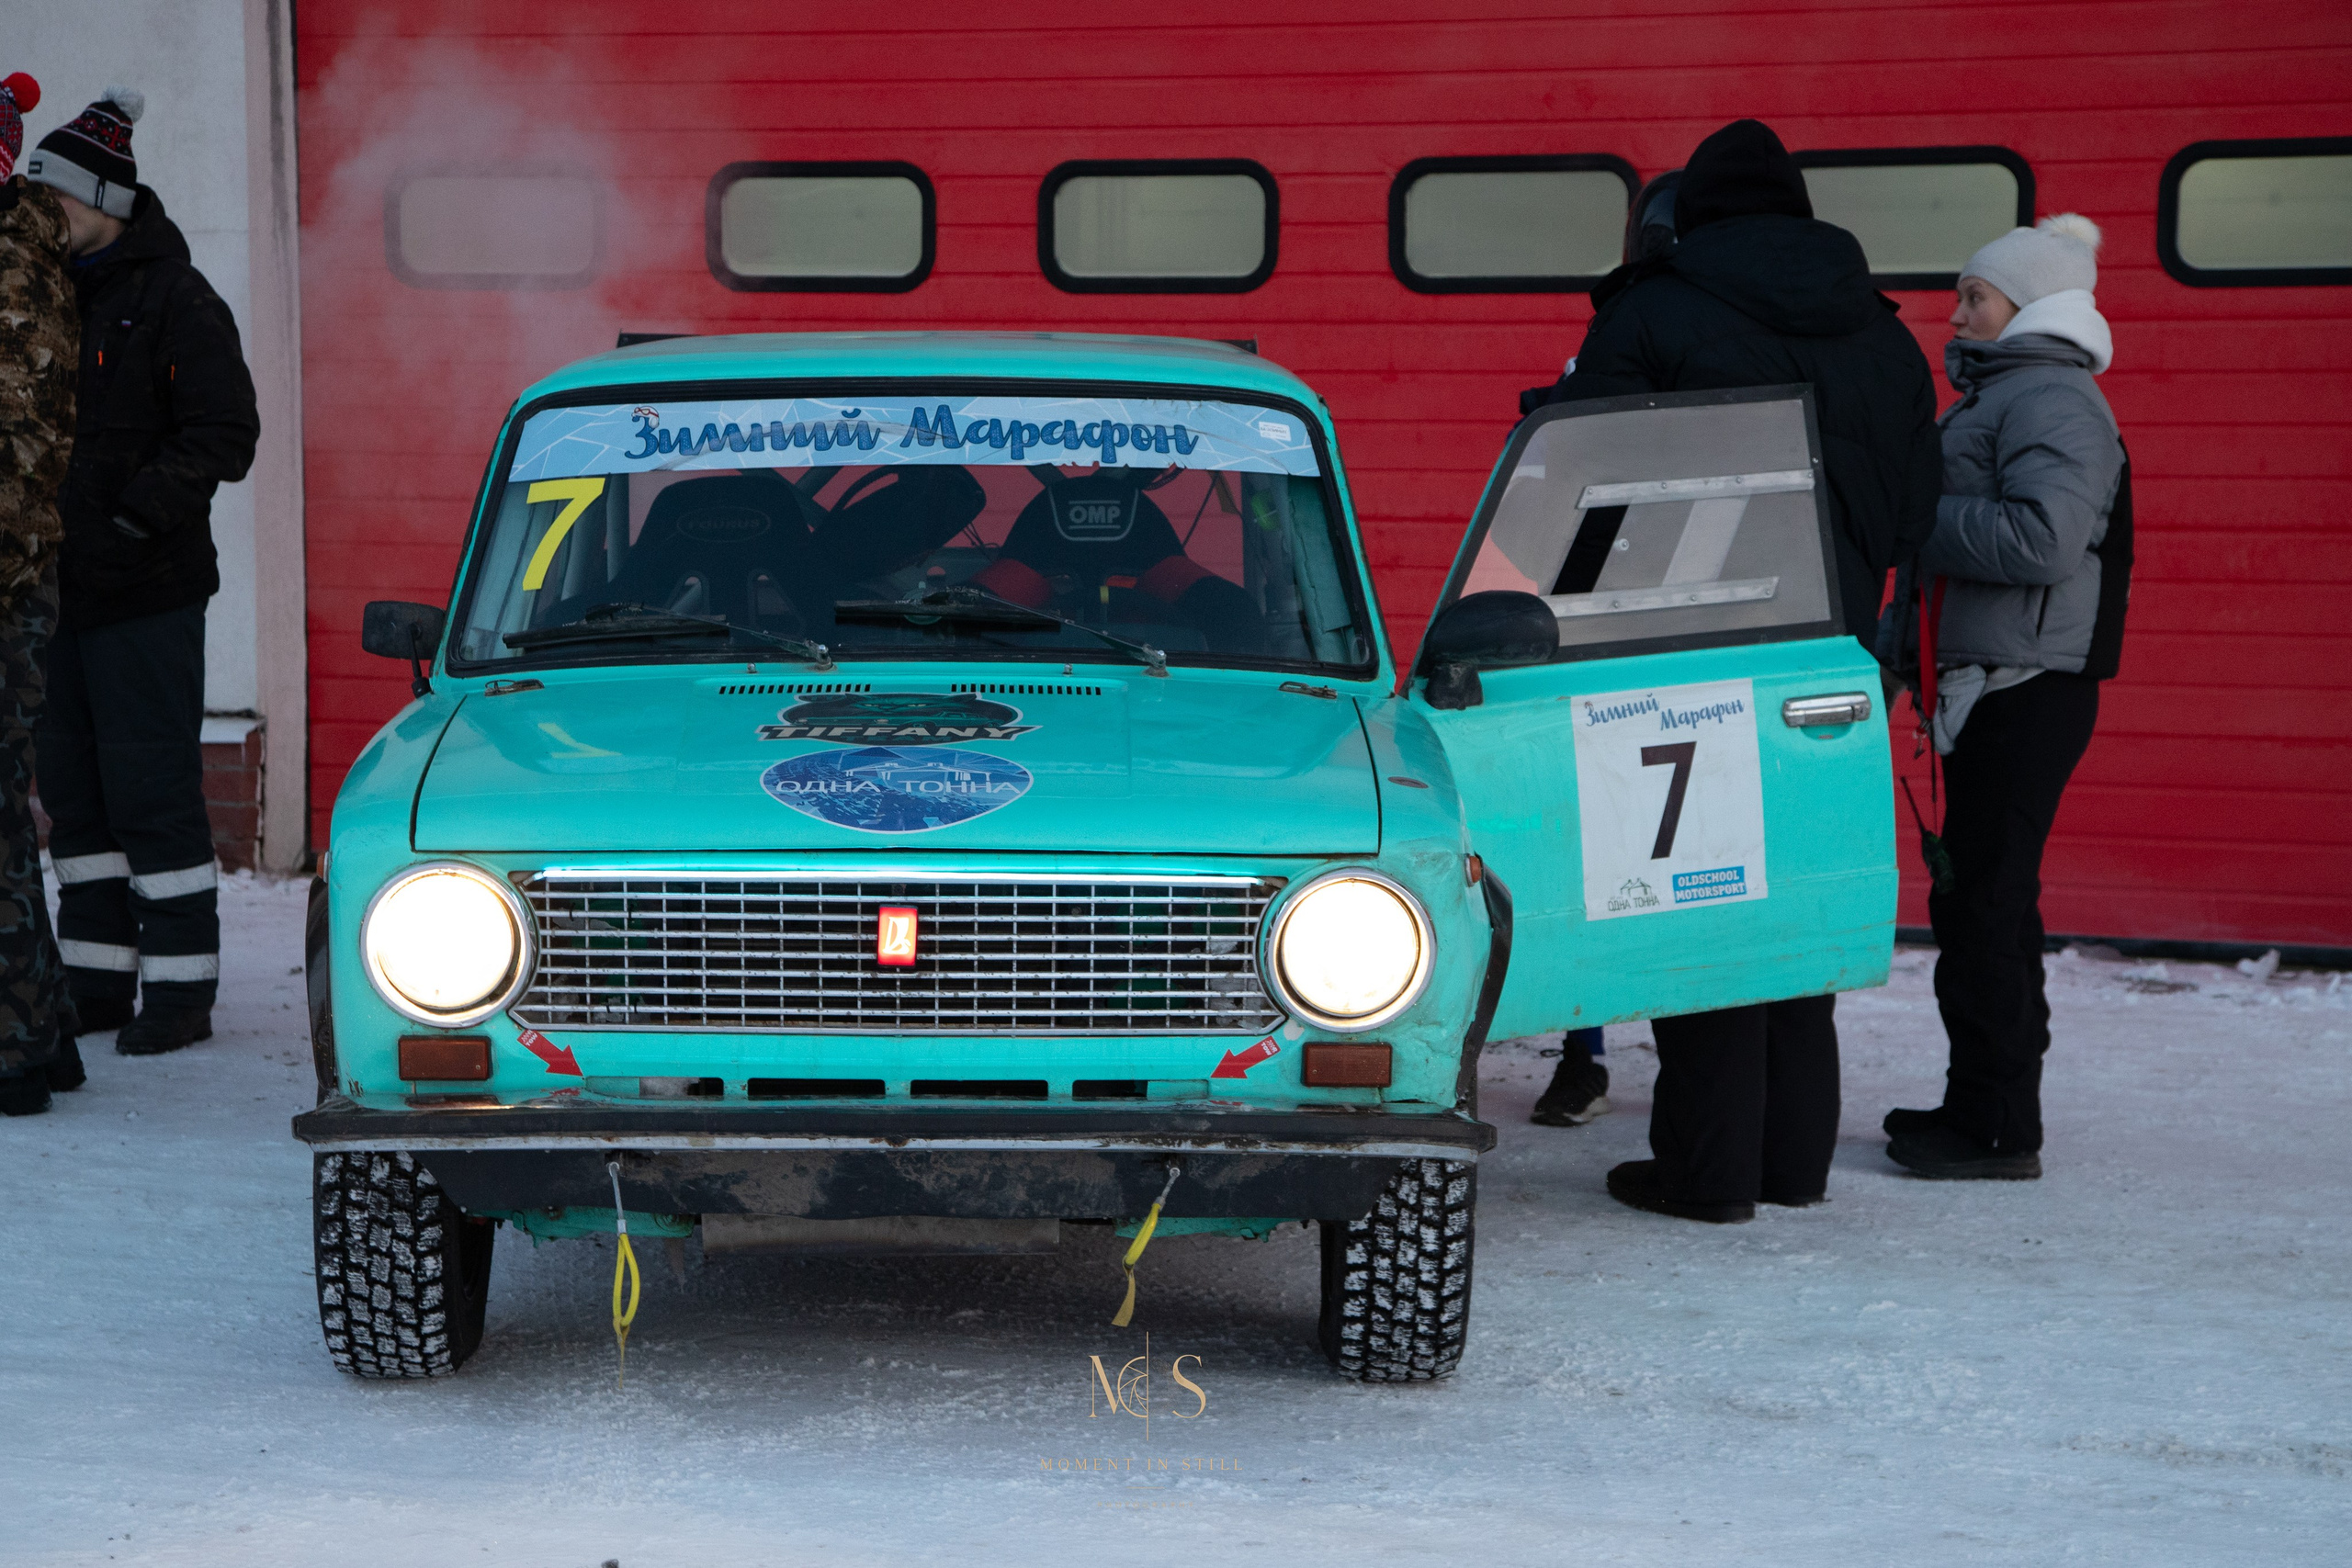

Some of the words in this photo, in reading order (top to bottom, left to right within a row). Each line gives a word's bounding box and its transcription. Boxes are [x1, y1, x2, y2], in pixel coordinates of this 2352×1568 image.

[625, 407, 880, 458] Зимний
[899, 404, 1199, 463] Марафон
[1069, 505, 1121, 524] OMP
[523, 477, 605, 591] 7
[1585, 694, 1659, 727] Зимний
[1660, 699, 1745, 730] Марафон
[773, 727, 1022, 738] TIFFANY
[775, 780, 882, 794] ОДНА
[898, 780, 1022, 795] ТОННА
[1641, 740, 1697, 860] 7
[1678, 870, 1740, 887] OLDSCHOOL
[1676, 883, 1746, 902] MOTORSPORT
[1608, 898, 1632, 912] ОДНА
[1634, 895, 1660, 908] ТОННА
[526, 1032, 537, 1046] TOW
[1261, 1042, 1273, 1055] TOW
